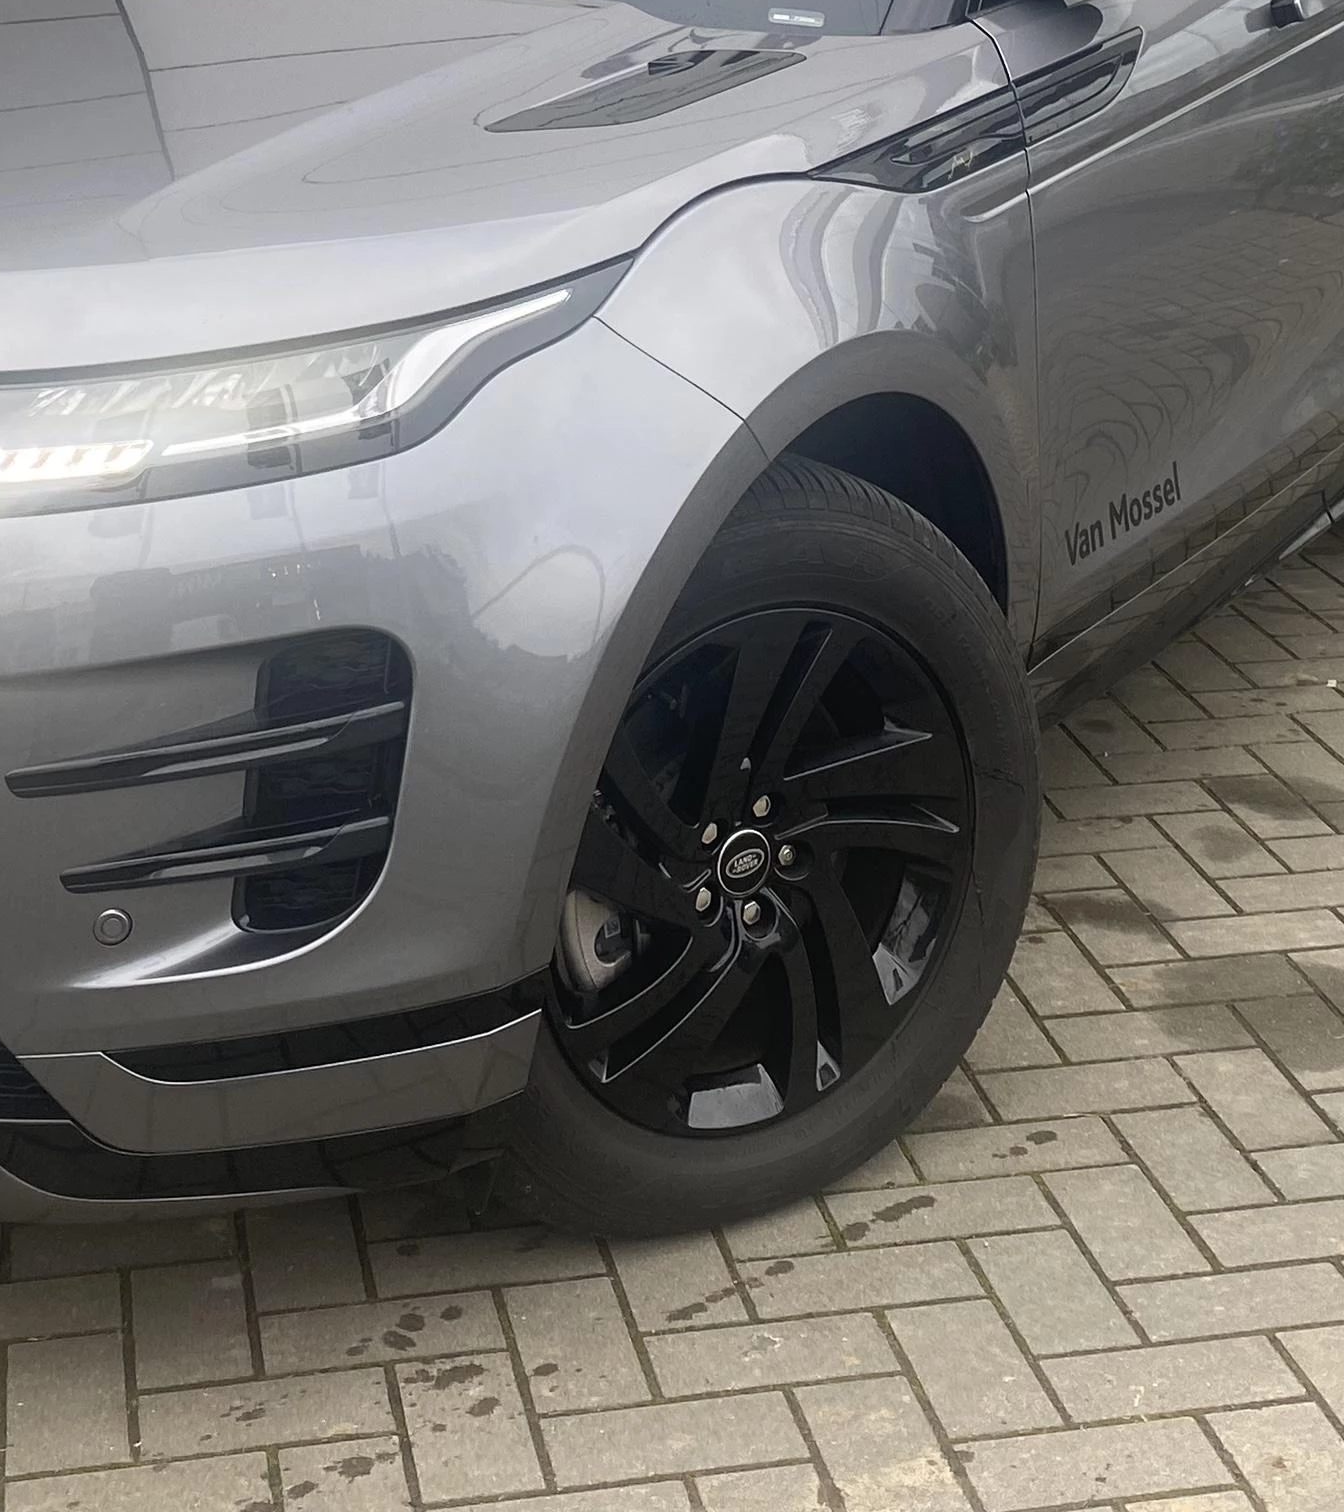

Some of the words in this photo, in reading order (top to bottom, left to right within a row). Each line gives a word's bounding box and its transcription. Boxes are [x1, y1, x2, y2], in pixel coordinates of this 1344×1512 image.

[1065, 521, 1104, 566] Van
[1109, 460, 1181, 539] Mossel
[734, 854, 753, 868] LAND
